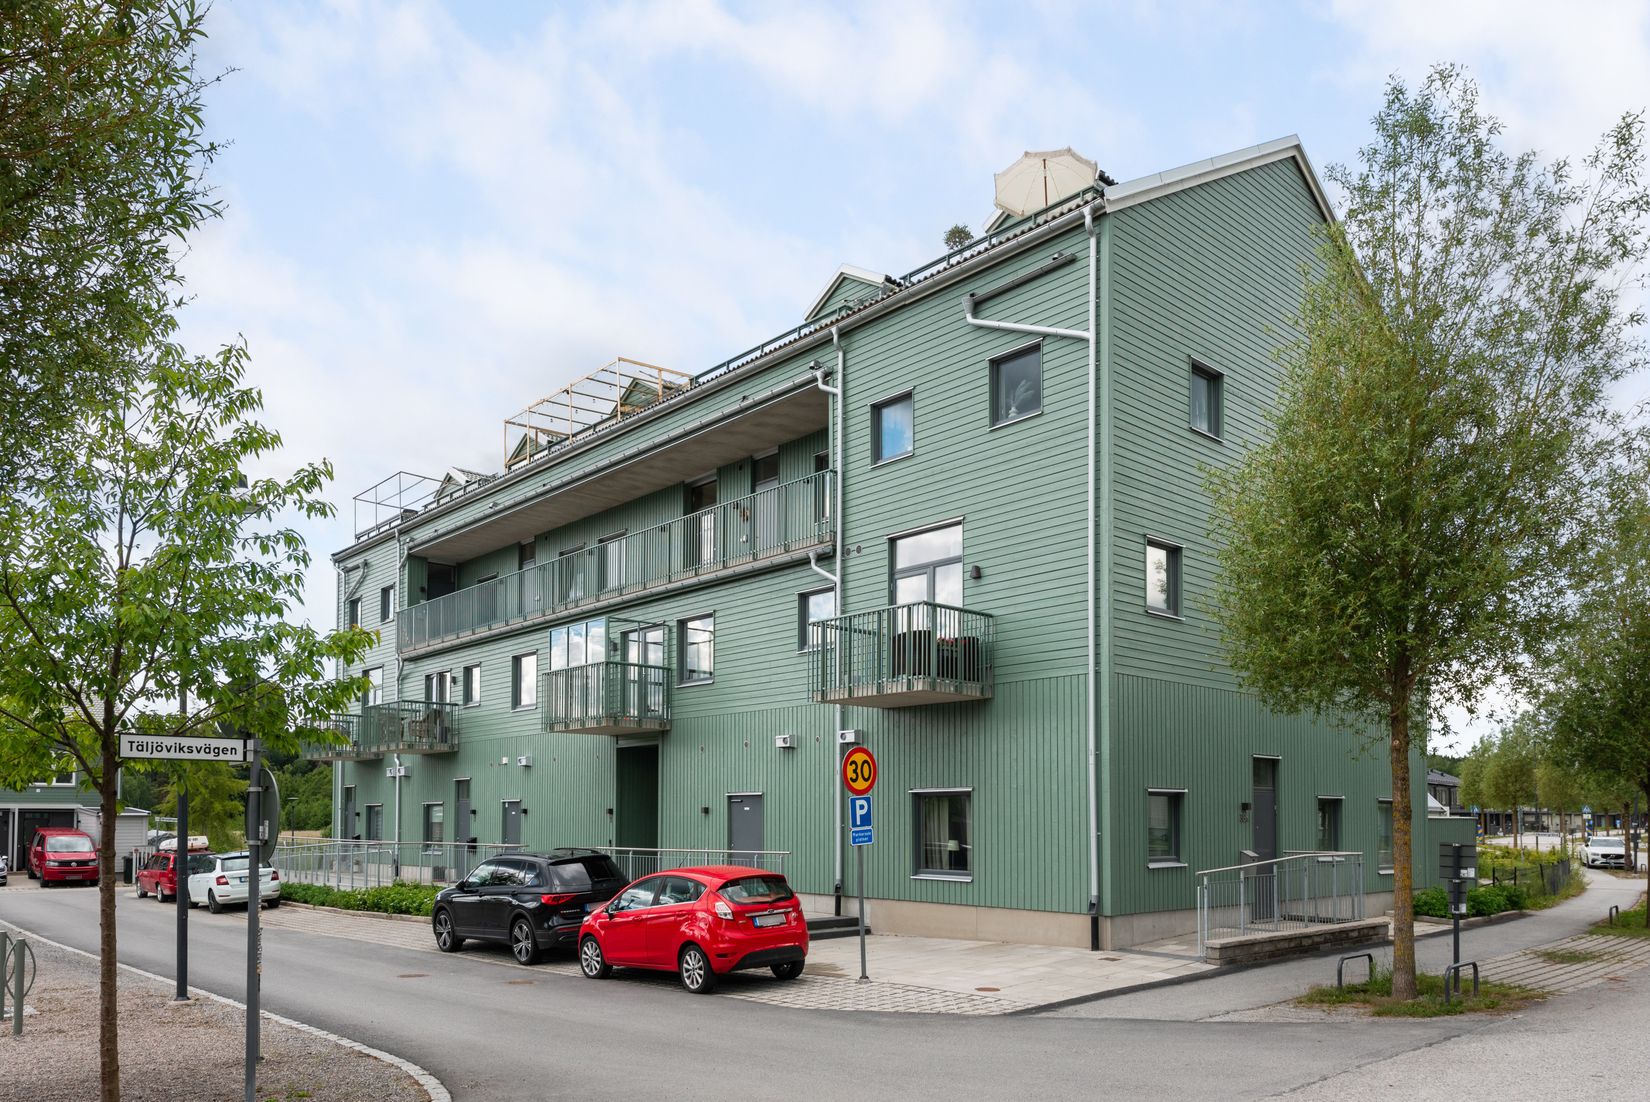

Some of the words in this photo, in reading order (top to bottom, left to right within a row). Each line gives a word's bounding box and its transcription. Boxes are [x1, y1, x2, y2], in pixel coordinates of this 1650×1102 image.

[128, 740, 237, 757] Täljöviksvägen
[849, 760, 872, 783] 30
[855, 800, 868, 825] P
